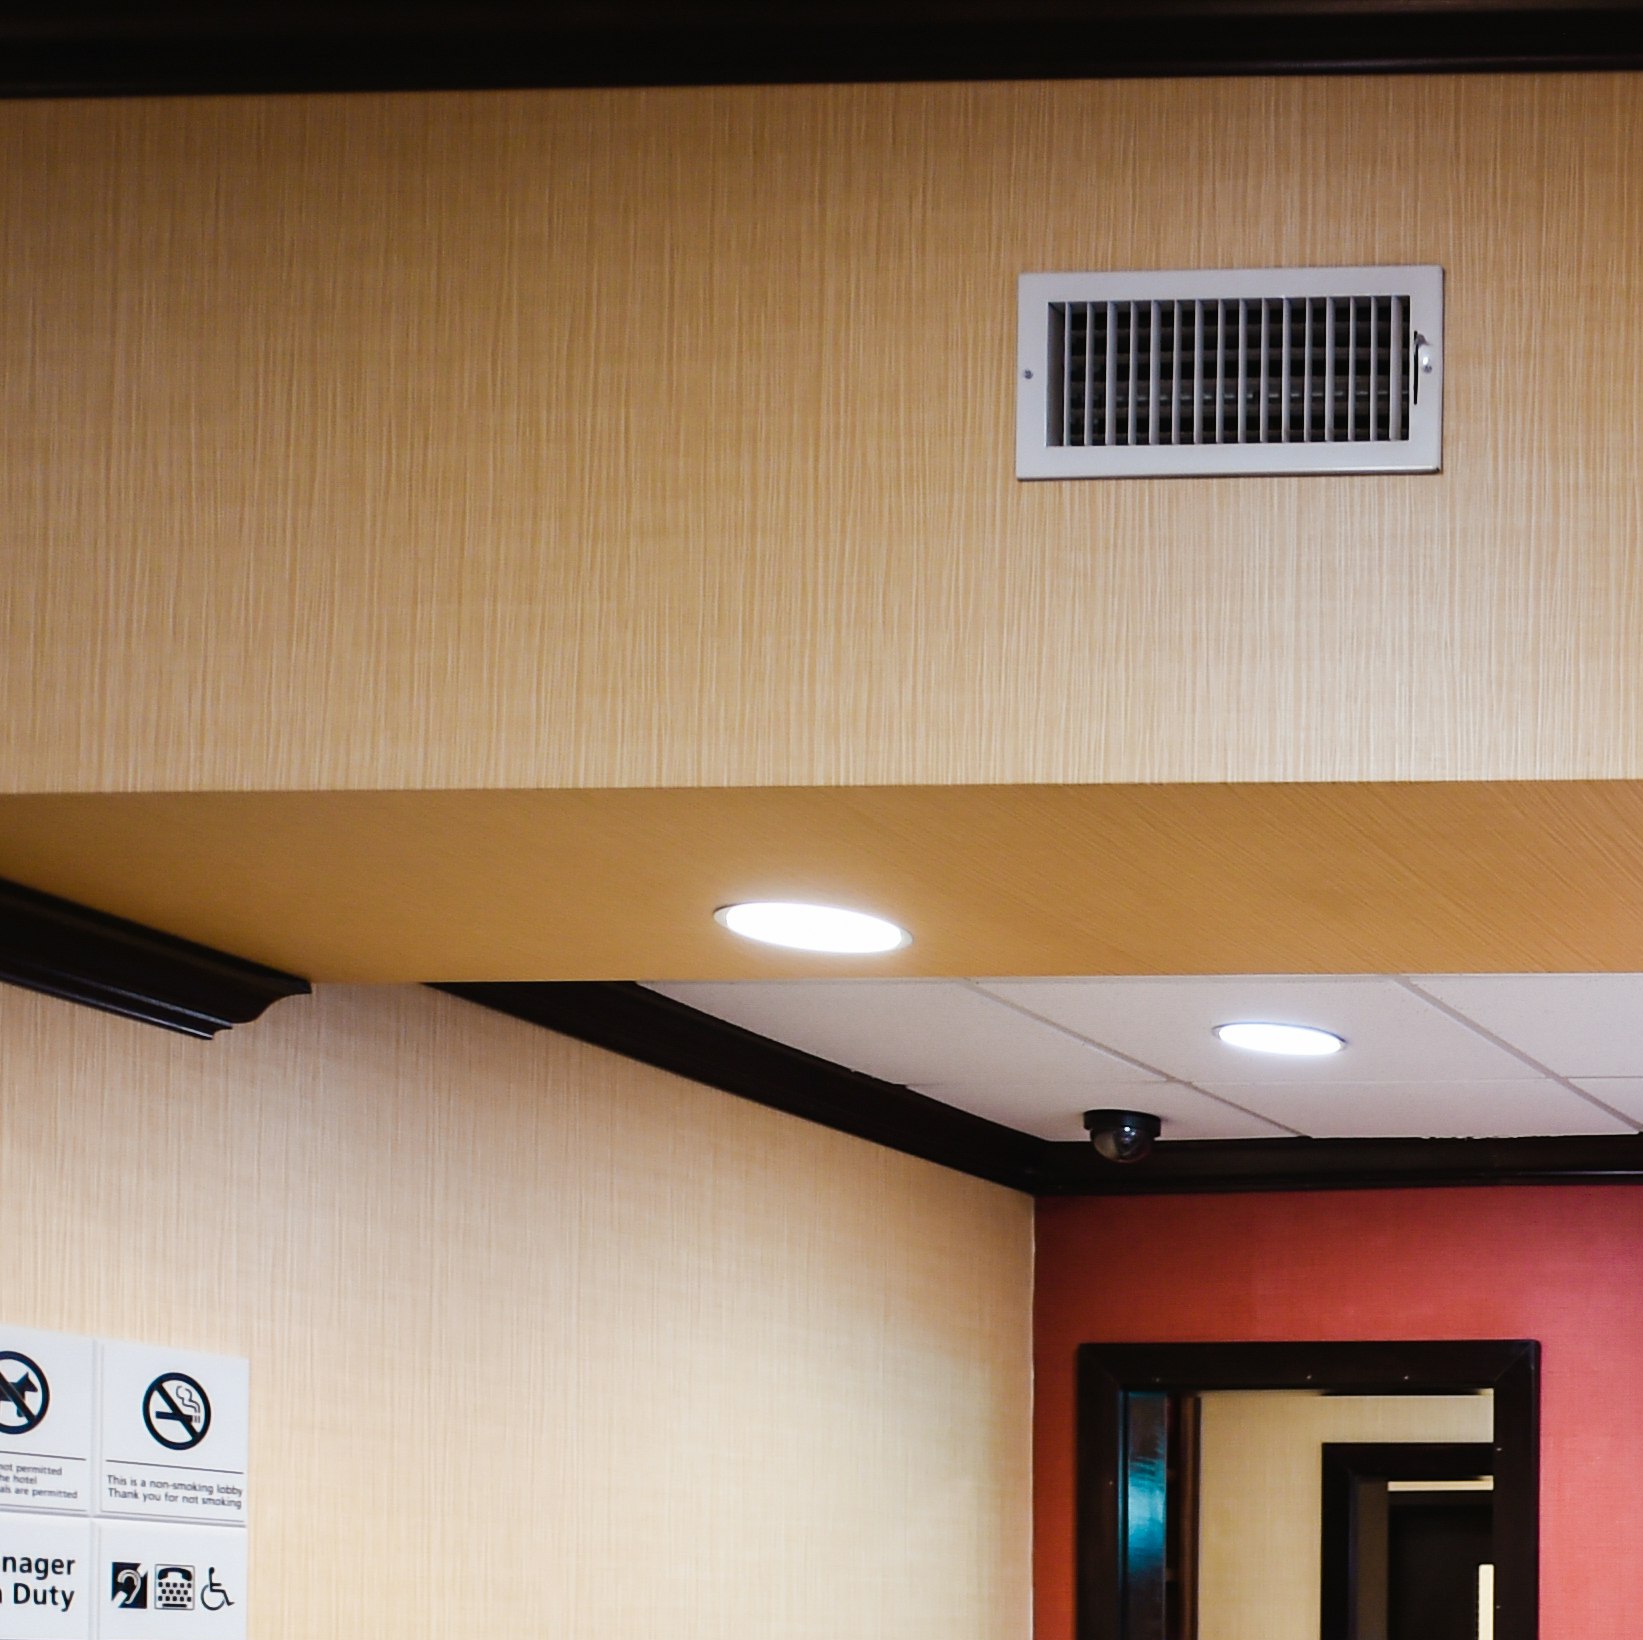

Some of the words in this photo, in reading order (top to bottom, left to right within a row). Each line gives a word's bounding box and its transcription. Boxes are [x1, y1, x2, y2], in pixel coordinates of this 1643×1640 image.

[16, 1465, 63, 1476] permitted
[13, 1474, 37, 1484] hotel
[107, 1475, 127, 1486] This
[150, 1480, 214, 1495] non-smoking
[216, 1483, 243, 1497] lobby
[32, 1489, 78, 1499] permitted
[108, 1487, 139, 1499] Thank
[143, 1492, 161, 1502] you
[164, 1491, 178, 1502] for
[182, 1494, 199, 1504] not
[202, 1496, 242, 1510] smoking
[13, 1582, 75, 1612] Duty
